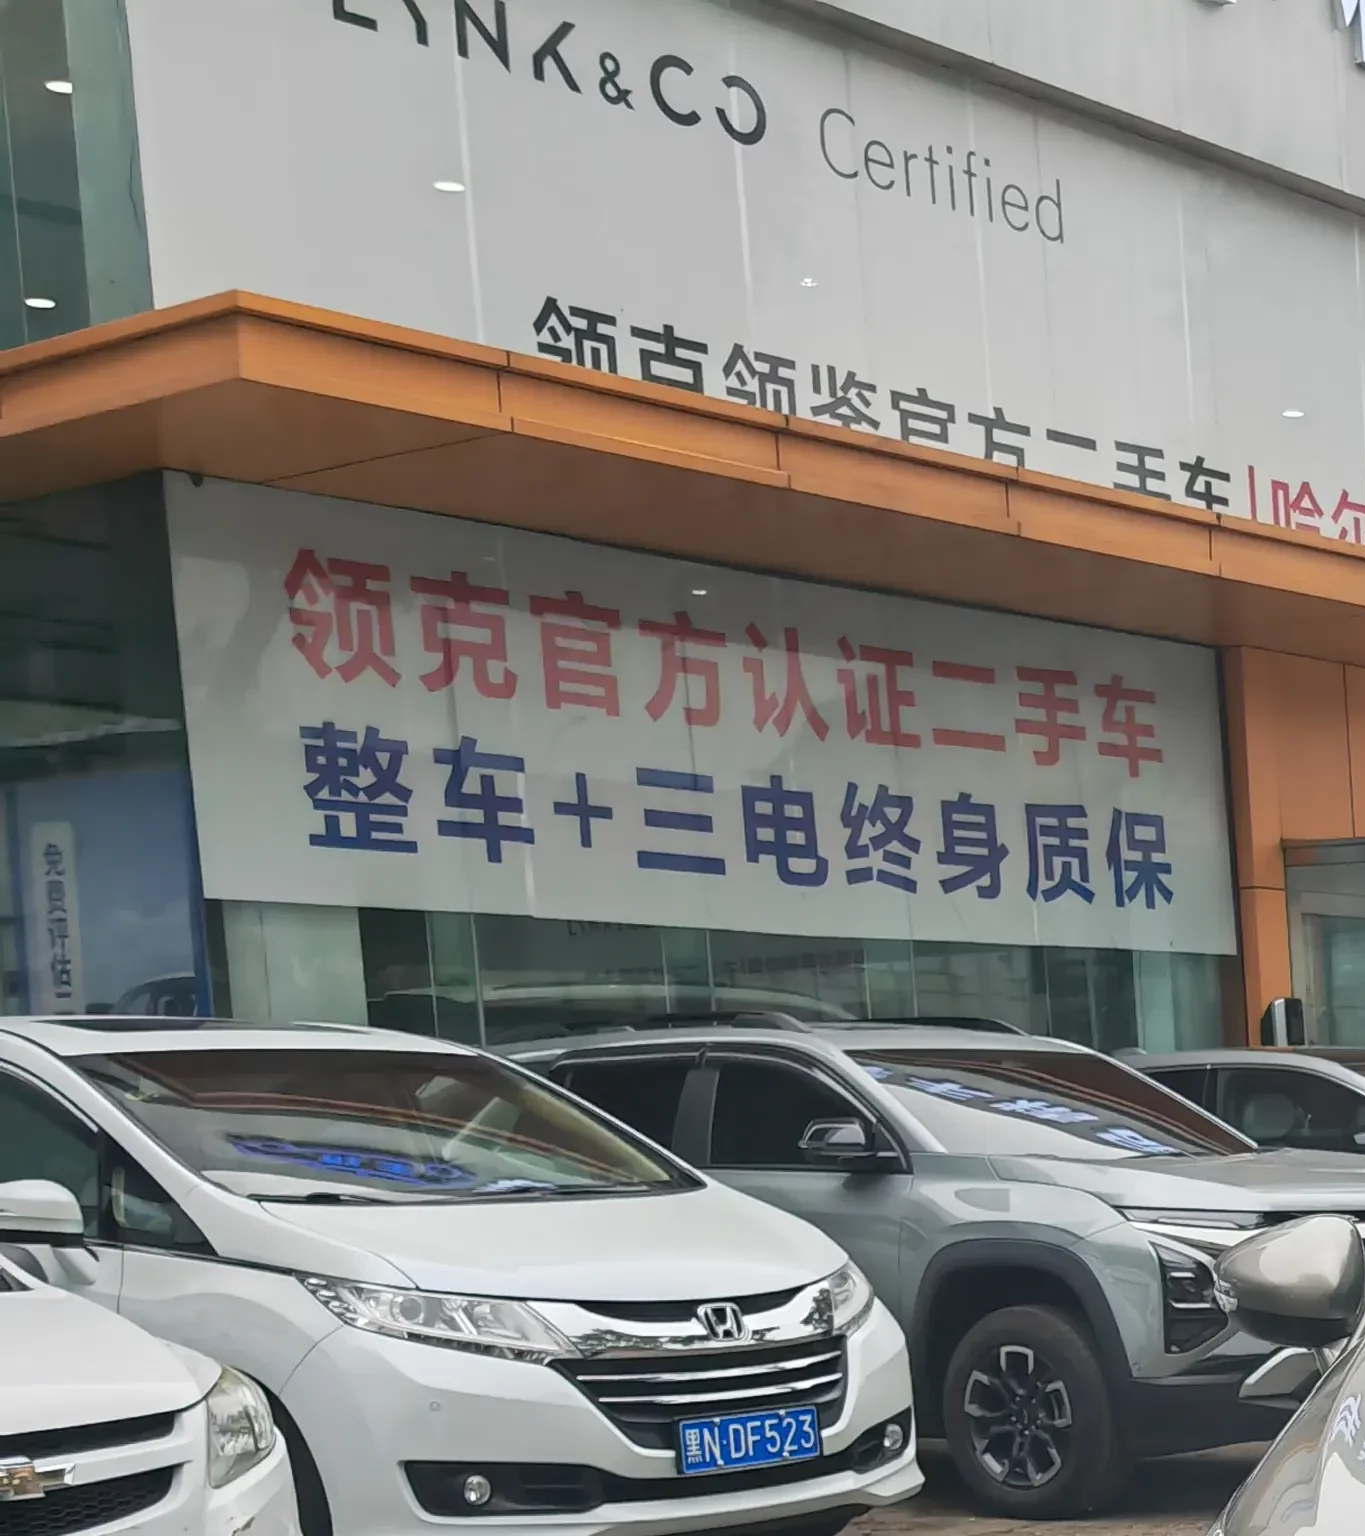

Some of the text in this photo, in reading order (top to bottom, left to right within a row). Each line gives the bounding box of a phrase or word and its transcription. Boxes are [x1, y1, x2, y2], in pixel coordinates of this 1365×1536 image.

[820, 107, 1064, 245] Certified
[283, 547, 1164, 778] 领克官方认证二手车
[299, 721, 1175, 911] 整车+三电终身质保
[684, 1414, 816, 1465] 黑N·DF523
